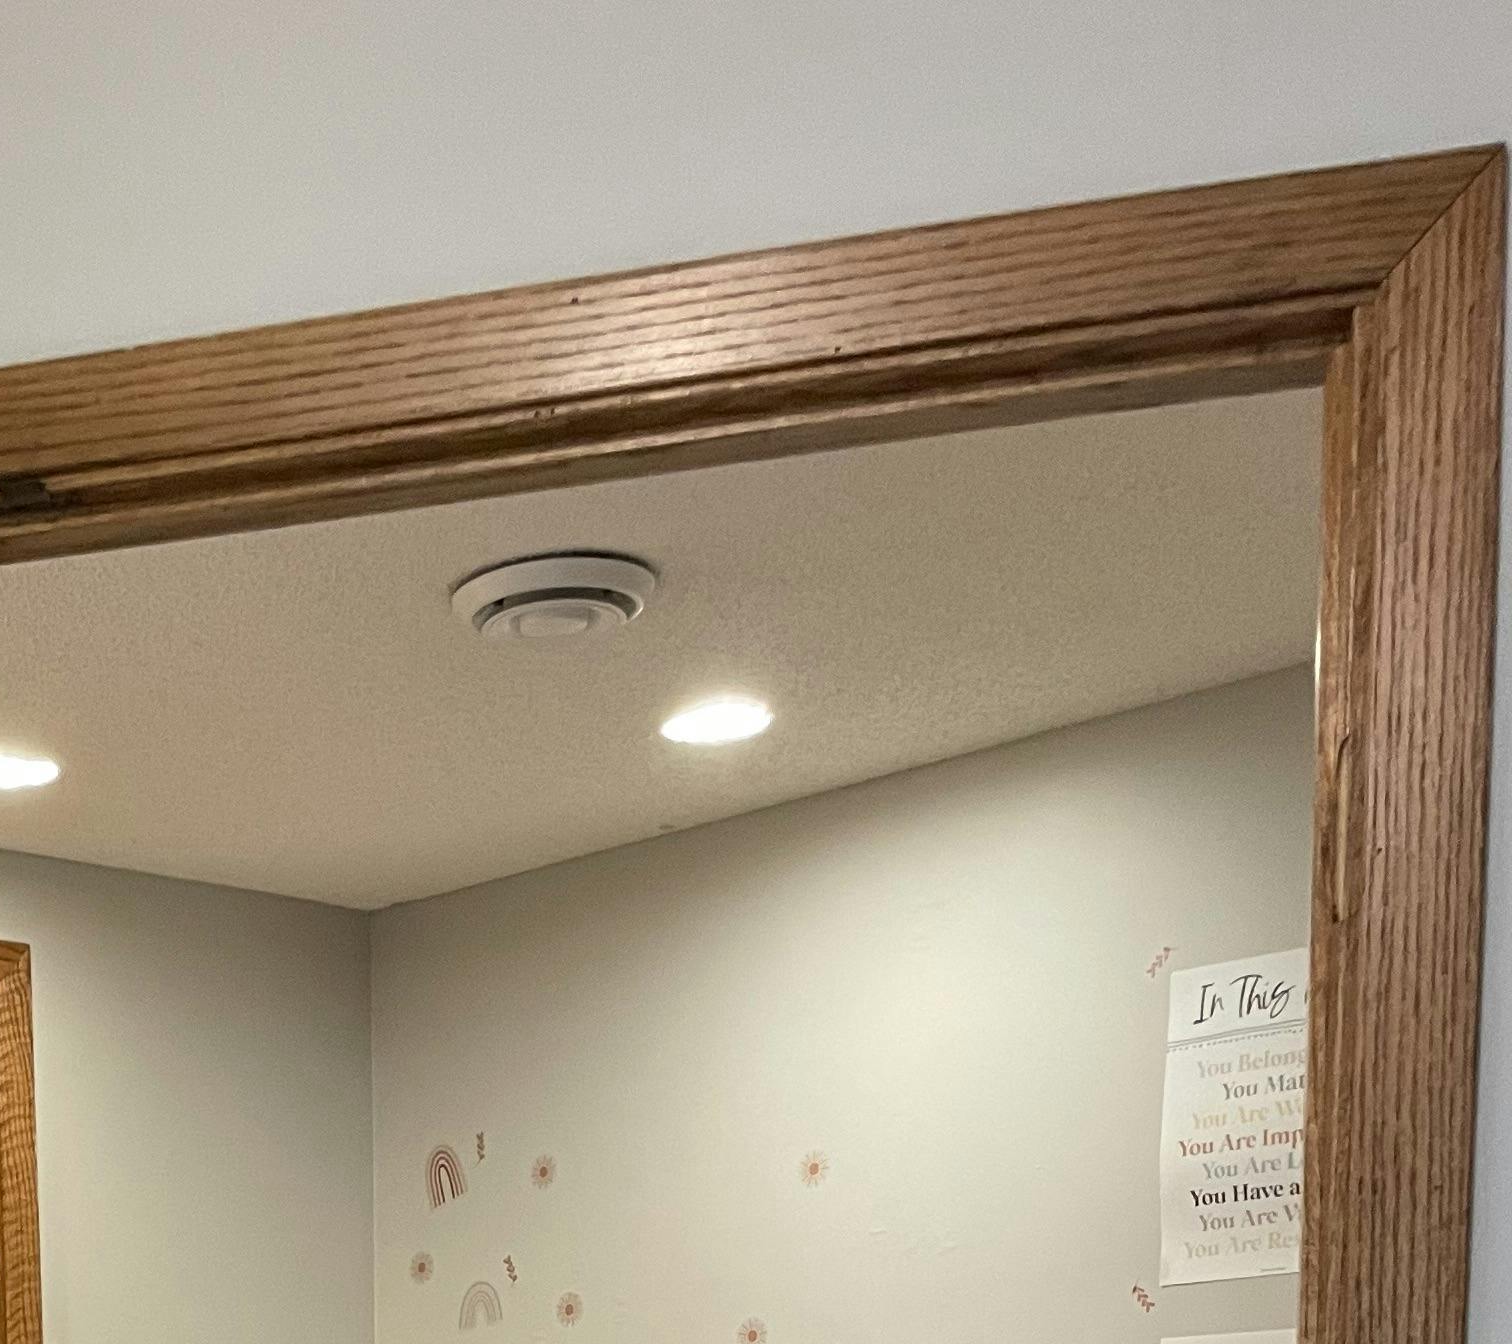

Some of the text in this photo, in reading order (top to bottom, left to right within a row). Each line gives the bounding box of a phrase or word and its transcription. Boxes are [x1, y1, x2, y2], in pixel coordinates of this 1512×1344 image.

[1193, 974, 1296, 1025] In This
[1196, 1060, 1232, 1078] You
[1221, 1081, 1258, 1101] You
[1178, 1138, 1214, 1157] You
[1219, 1133, 1257, 1153] Are
[1202, 1151, 1303, 1179] You Are L
[1190, 1189, 1227, 1207] You
[1232, 1183, 1284, 1202] Have
[1199, 1203, 1301, 1232] You Are V
[1184, 1241, 1220, 1259] You
